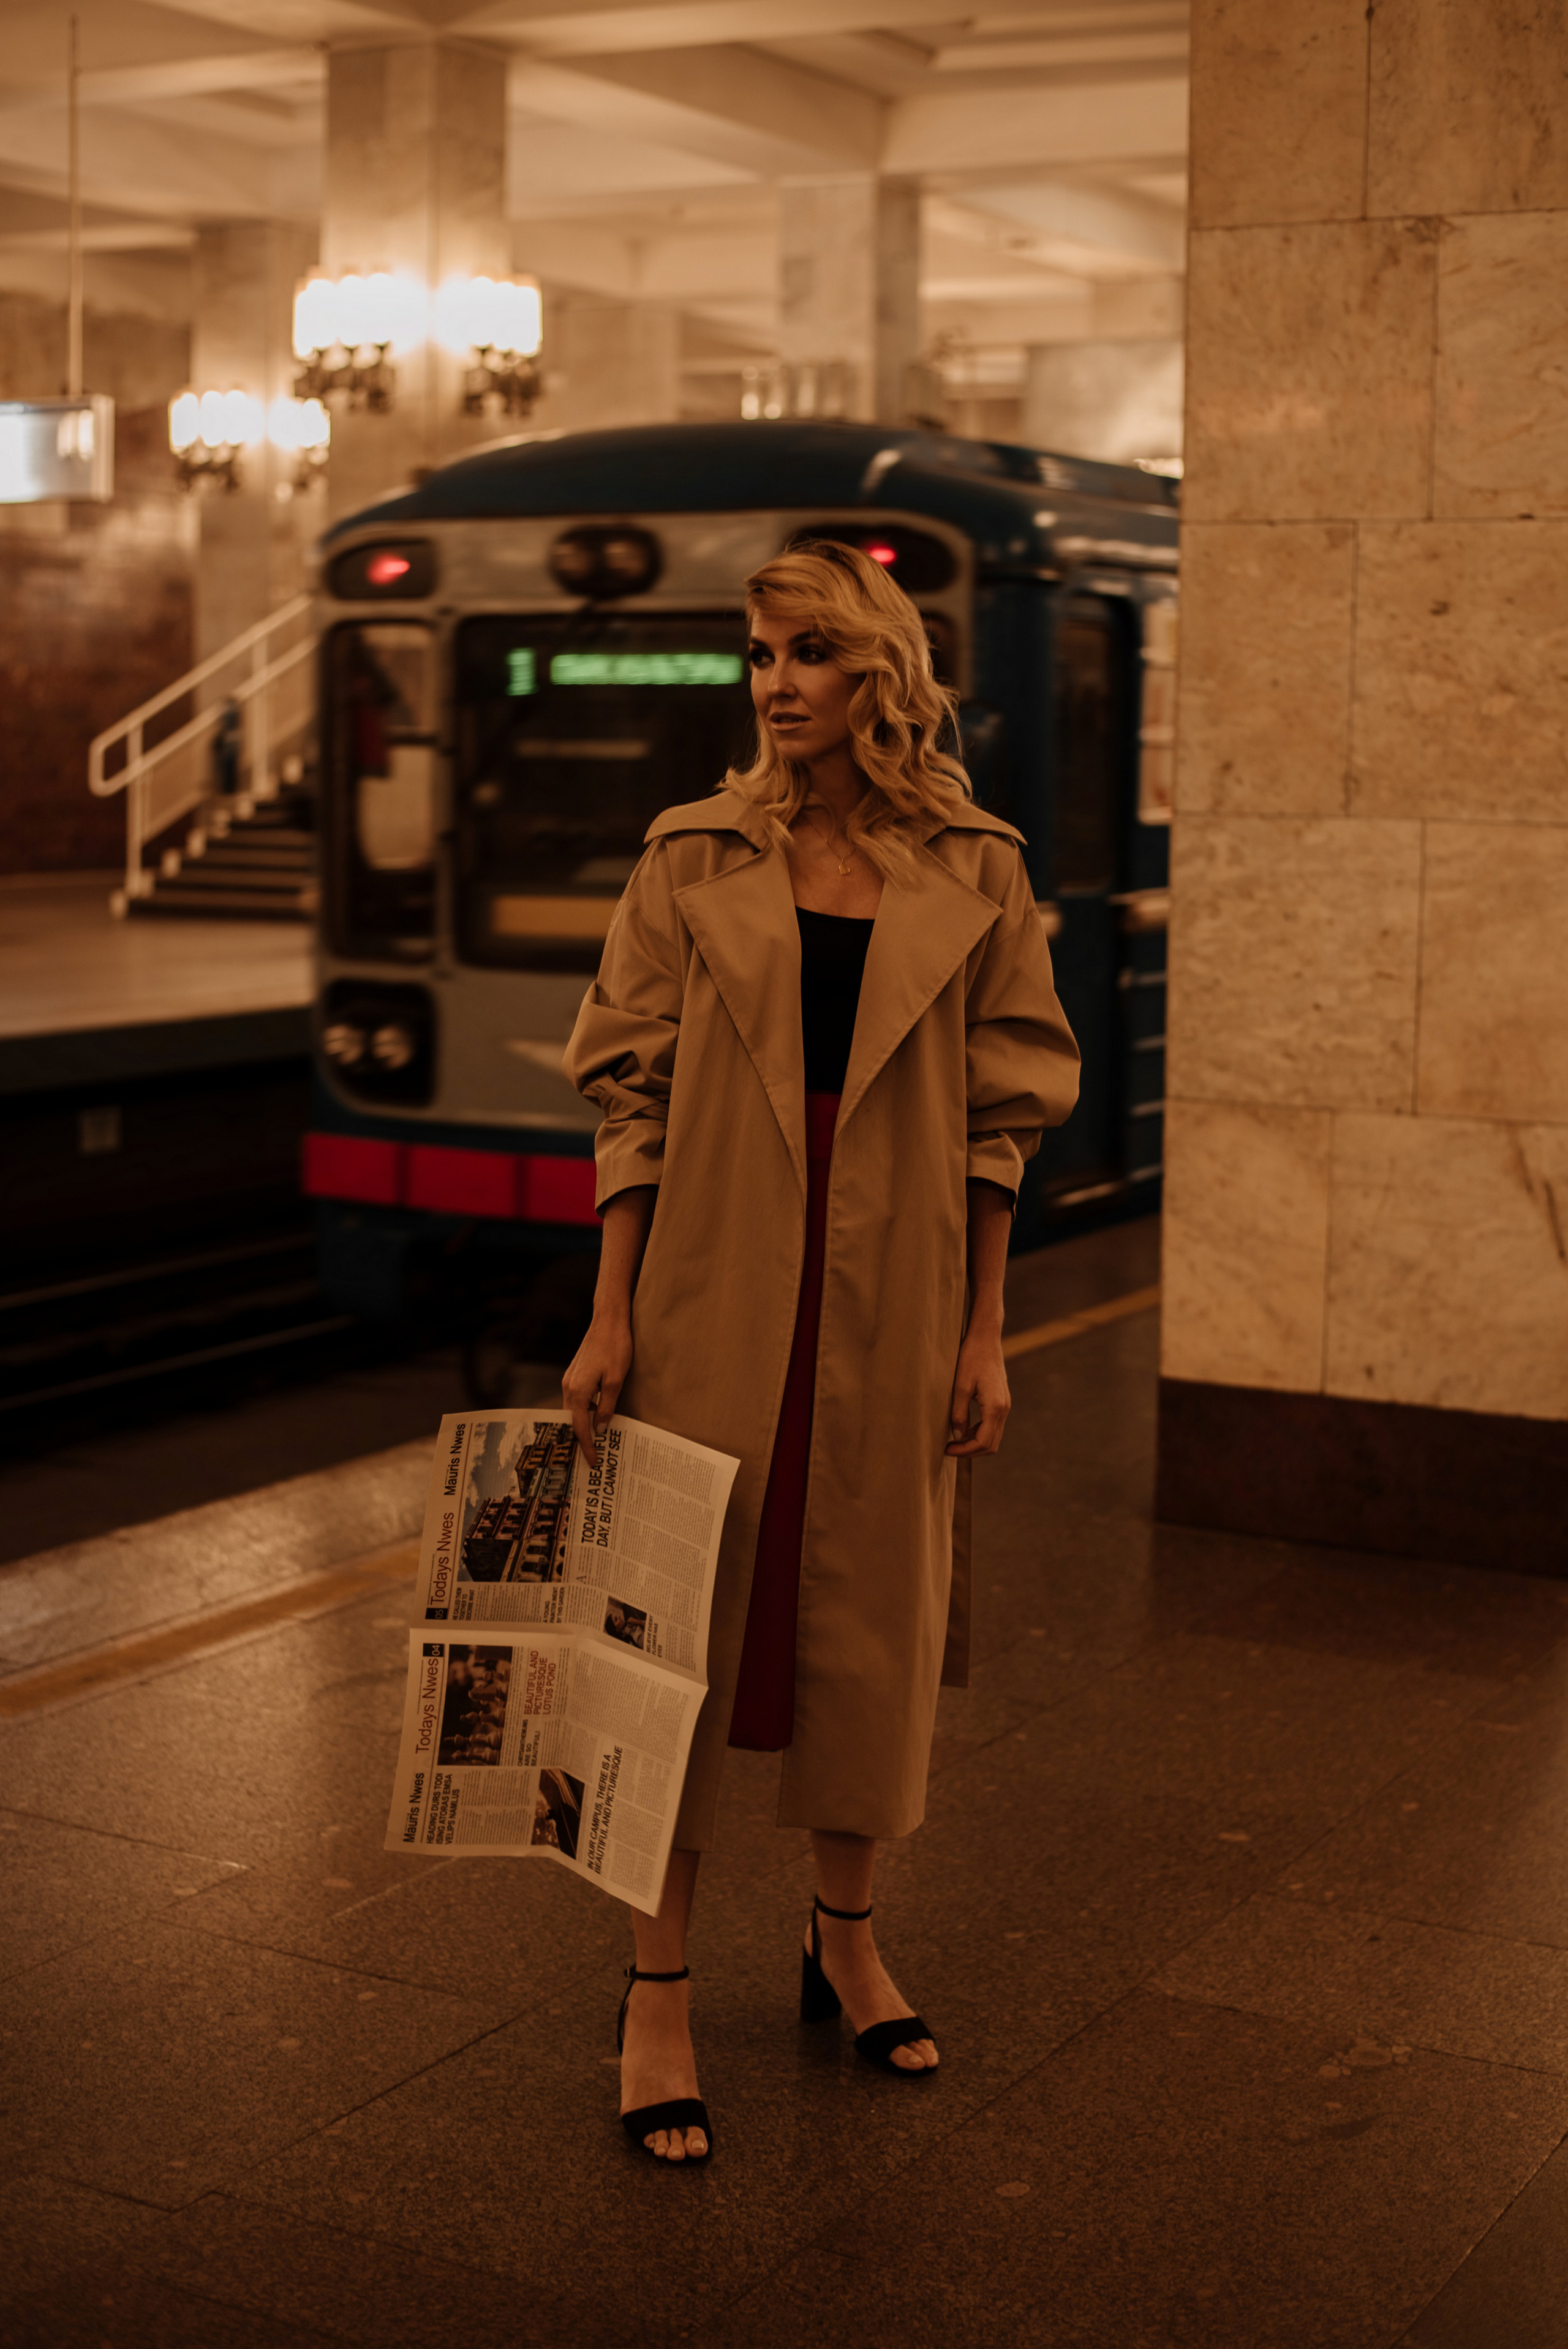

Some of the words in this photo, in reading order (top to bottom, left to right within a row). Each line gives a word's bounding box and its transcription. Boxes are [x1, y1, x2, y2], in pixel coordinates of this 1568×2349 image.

[450, 1424, 466, 1454] Nwes
[609, 1429, 622, 1451] SEE
[443, 1458, 459, 1495] Mauris
[603, 1451, 619, 1496] CANNOT
[586, 1497, 598, 1508] IS
[600, 1500, 612, 1524] BUT
[437, 1513, 454, 1551] Nwes
[581, 1508, 597, 1543] TODAY
[597, 1526, 611, 1548] DAY,
[430, 1557, 451, 1605] Todays
[576, 1575, 586, 1584] A
[435, 1610, 443, 1619] 05
[432, 1645, 440, 1656] 04
[530, 1651, 538, 1668] AND
[422, 1659, 439, 1699] Nwes
[533, 1658, 548, 1715] PICTURESQUE
[546, 1663, 556, 1686] POND
[524, 1670, 537, 1714] BEAUTIFUL
[543, 1688, 553, 1714] LOTUS
[415, 1704, 437, 1754] Todays
[526, 1744, 532, 1752] SO
[531, 1731, 540, 1766] BEAUTIFUL!
[601, 1761, 610, 1771] IS
[605, 1746, 622, 1807] PICTURESQUE
[409, 1773, 424, 1803] Nwes
[434, 1773, 443, 1790] TODI
[443, 1774, 452, 1794] EMSA
[596, 1771, 608, 1799] THERE
[431, 1791, 440, 1811] DURS
[439, 1796, 449, 1825] ATORAS
[449, 1789, 459, 1818] NAMLUS
[403, 1807, 419, 1842] Mauris
[426, 1813, 437, 1844] HEADING
[590, 1802, 604, 1839] CAMPUS,
[601, 1807, 611, 1827] AND
[436, 1826, 445, 1844] ISING
[445, 1820, 455, 1845] VELIPS
[587, 1840, 596, 1859] OUR
[595, 1828, 608, 1874] BEAUTIFUL
[587, 1859, 594, 1870] IN
